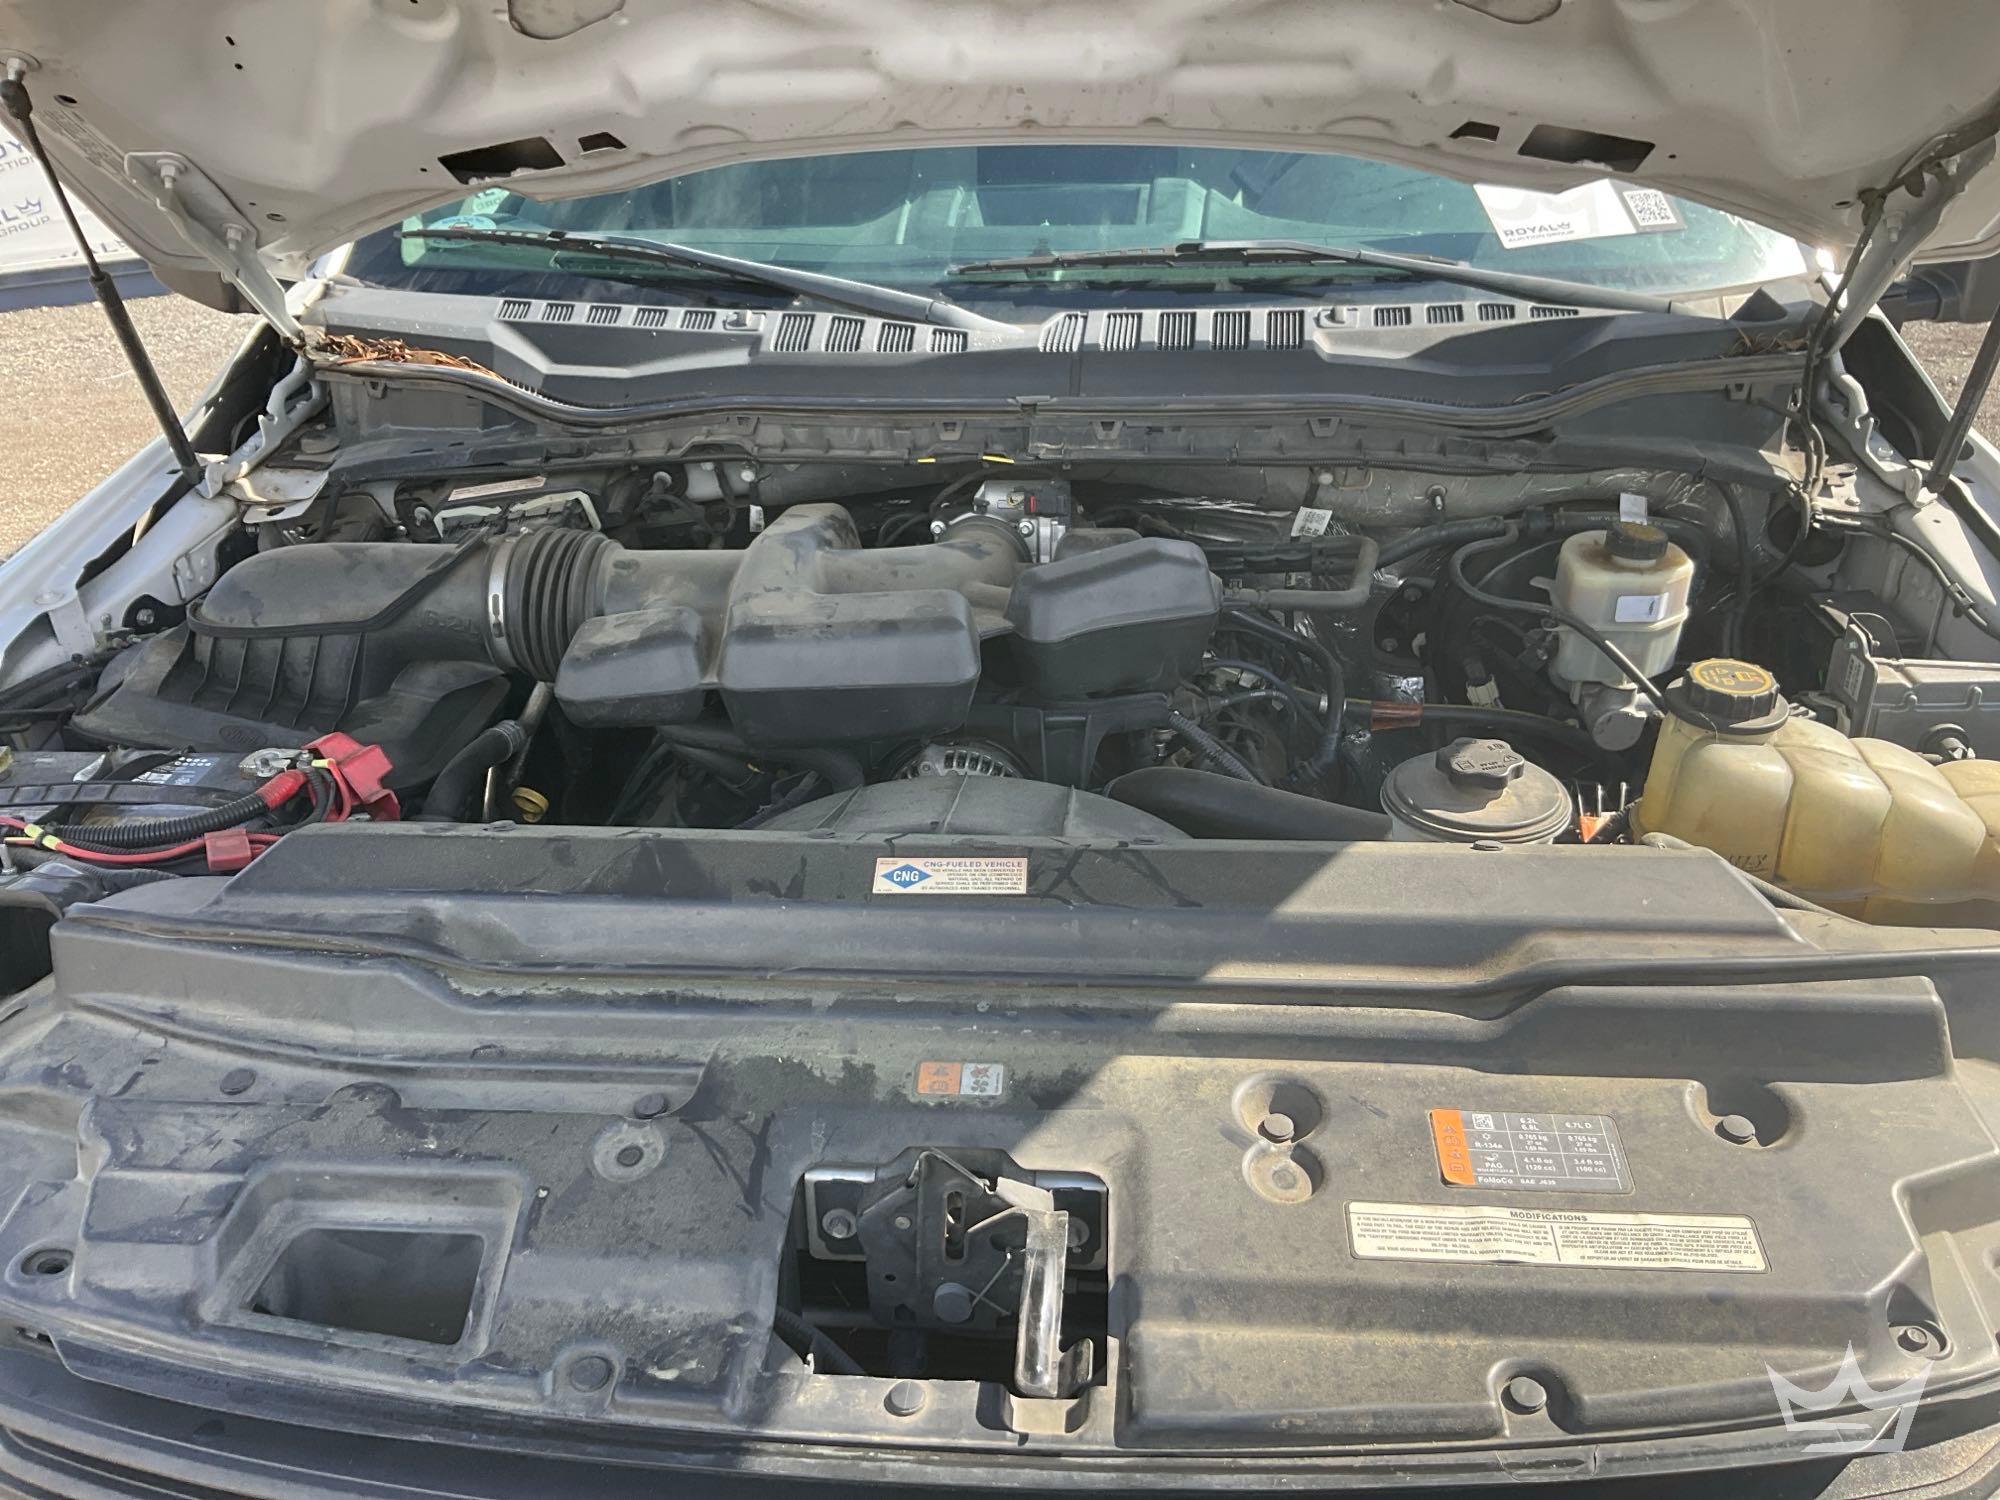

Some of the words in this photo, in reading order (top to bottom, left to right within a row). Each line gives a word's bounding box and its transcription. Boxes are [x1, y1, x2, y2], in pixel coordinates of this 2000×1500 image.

[1503, 225, 1558, 237] ROYAL
[893, 870, 919, 881] CNG
[1477, 1176, 1513, 1184] FoMoCo
[1510, 1211, 1588, 1221] MODIFICATIONS
